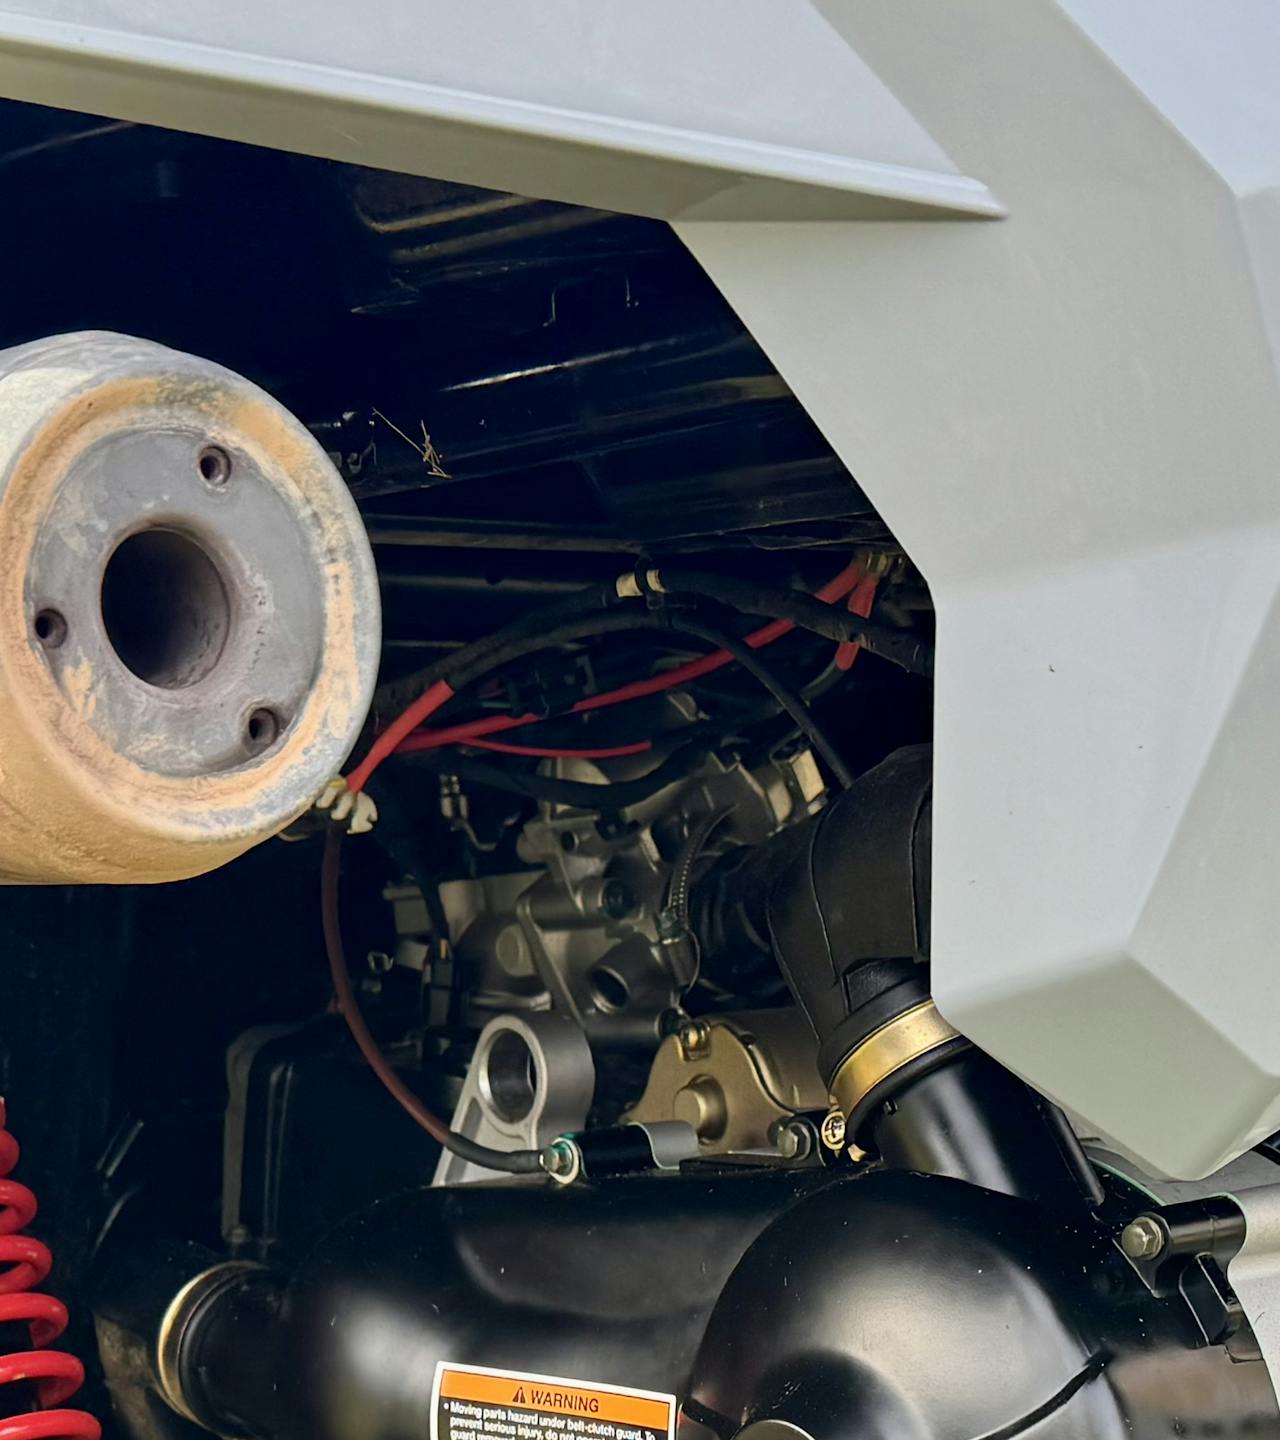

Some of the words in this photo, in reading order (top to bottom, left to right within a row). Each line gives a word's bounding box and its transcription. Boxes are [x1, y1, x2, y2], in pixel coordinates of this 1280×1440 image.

[531, 1390, 599, 1412] WARNING
[450, 1401, 482, 1418] Moving
[483, 1409, 506, 1420] parts
[508, 1410, 538, 1425] hazard
[540, 1416, 565, 1429] under
[567, 1419, 614, 1437] belt-clutch
[450, 1417, 482, 1430] prevent
[484, 1421, 516, 1434] serious
[518, 1424, 544, 1440] injury,
[545, 1429, 558, 1440] do
